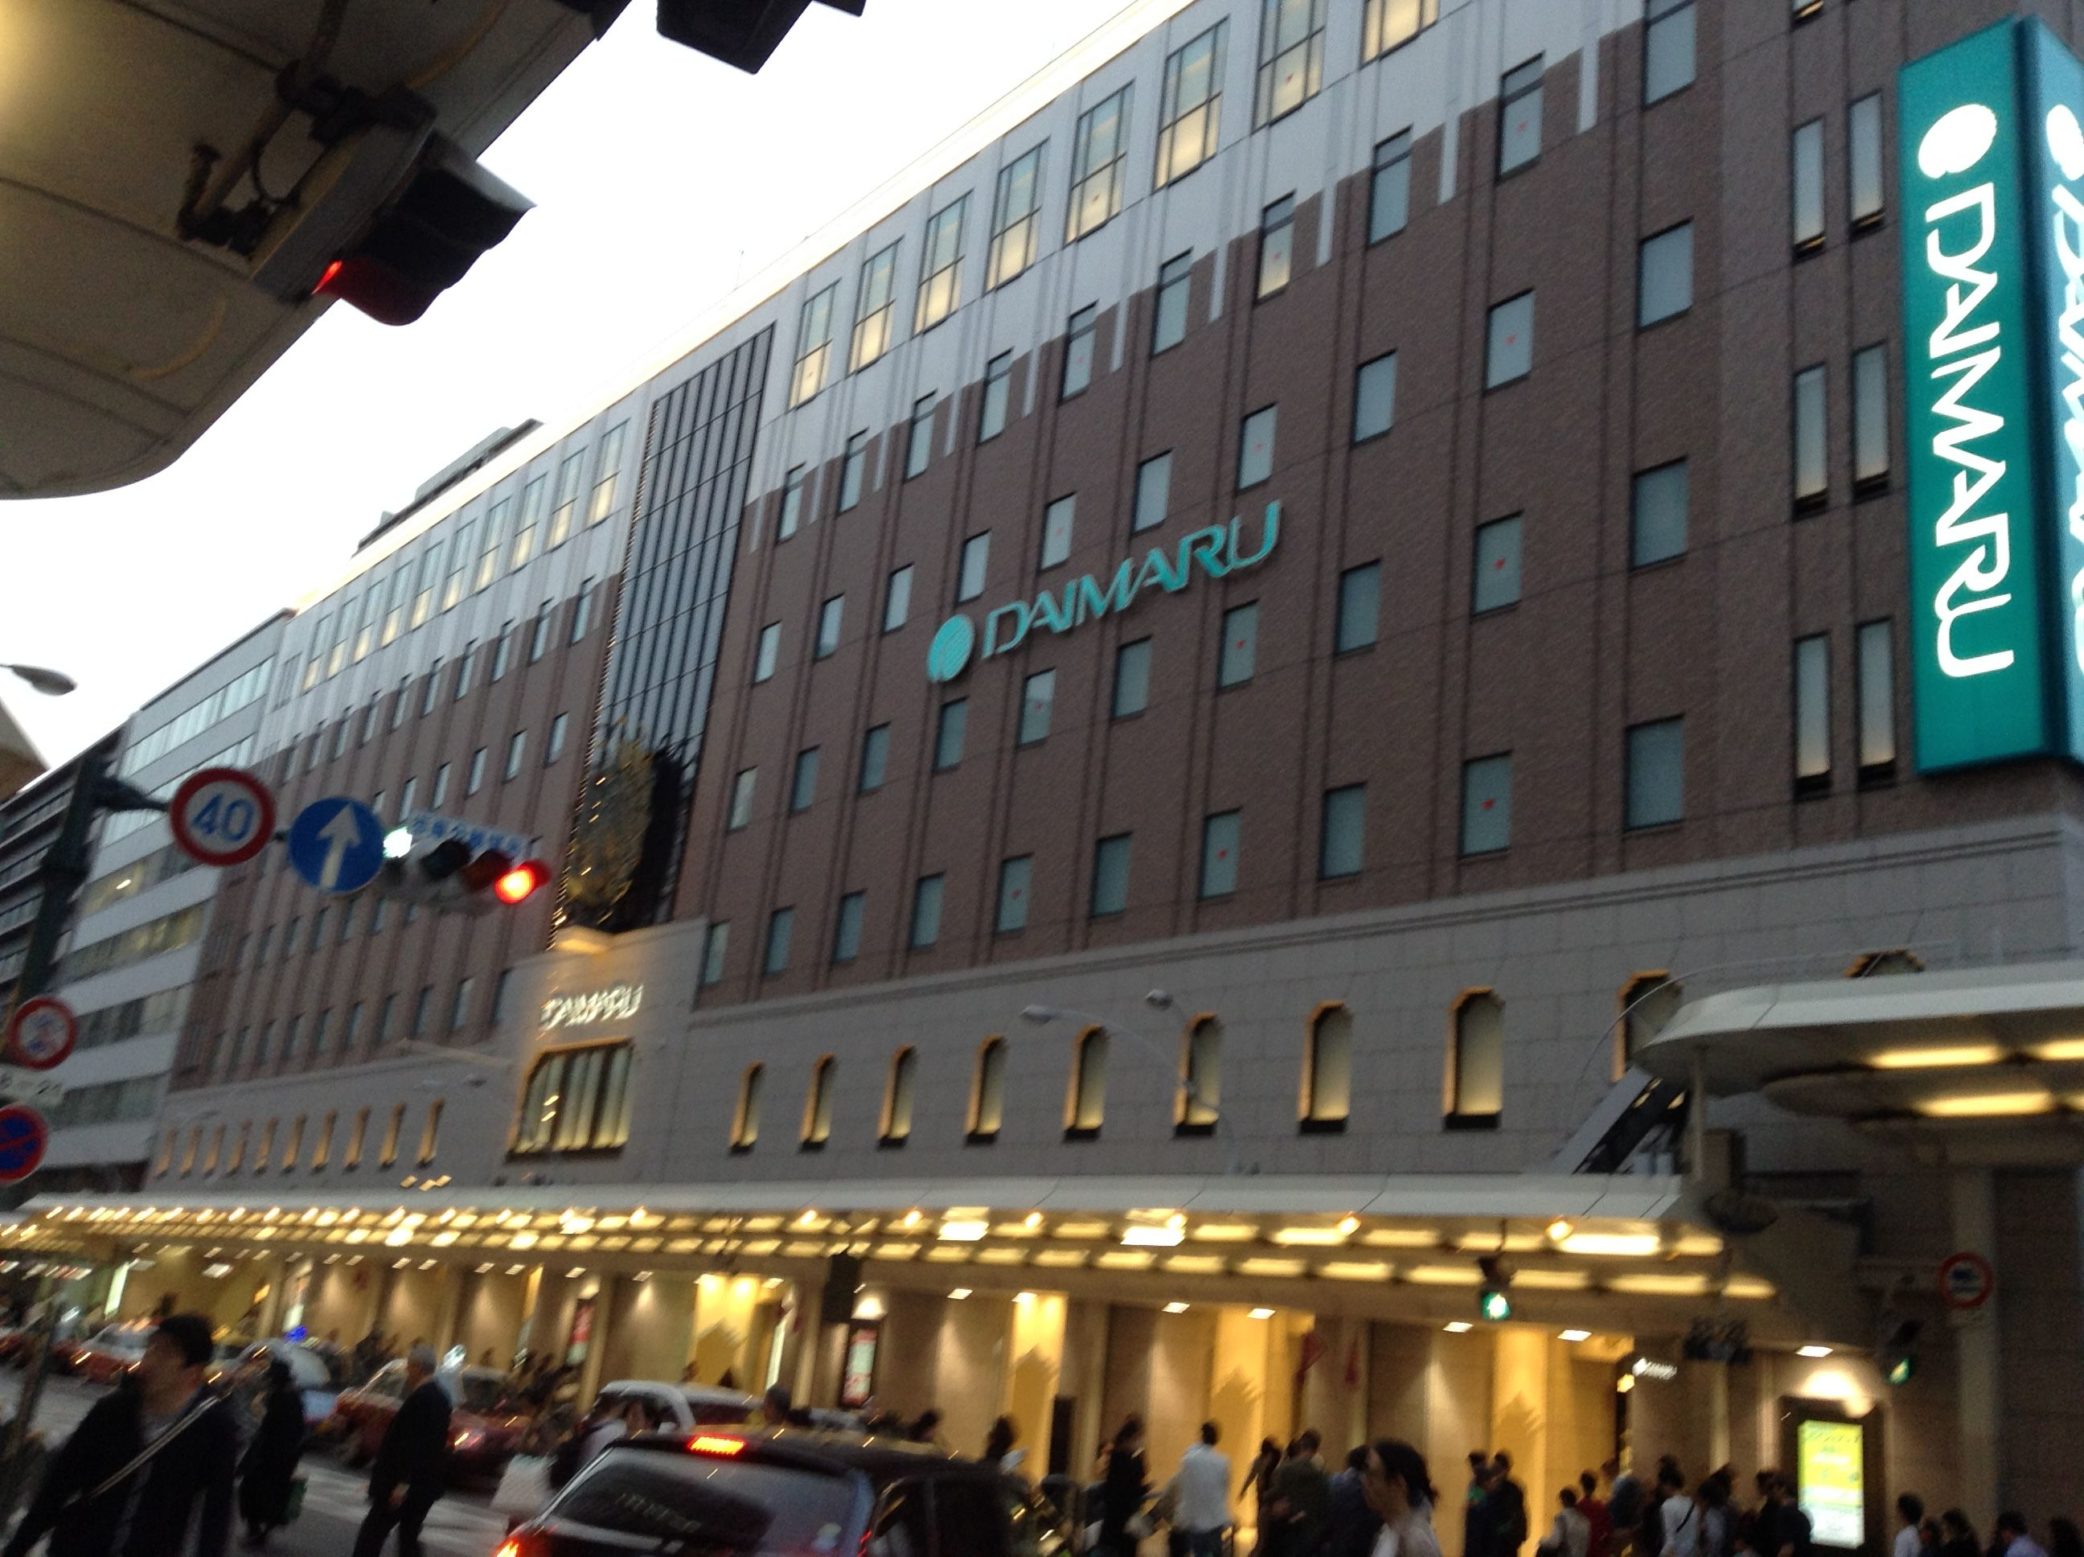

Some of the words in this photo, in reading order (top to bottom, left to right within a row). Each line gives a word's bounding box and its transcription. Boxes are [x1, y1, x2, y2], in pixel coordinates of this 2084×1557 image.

[1925, 183, 2015, 680] DAIMARU
[981, 500, 1282, 660] DAIMARU
[191, 793, 254, 842] 40
